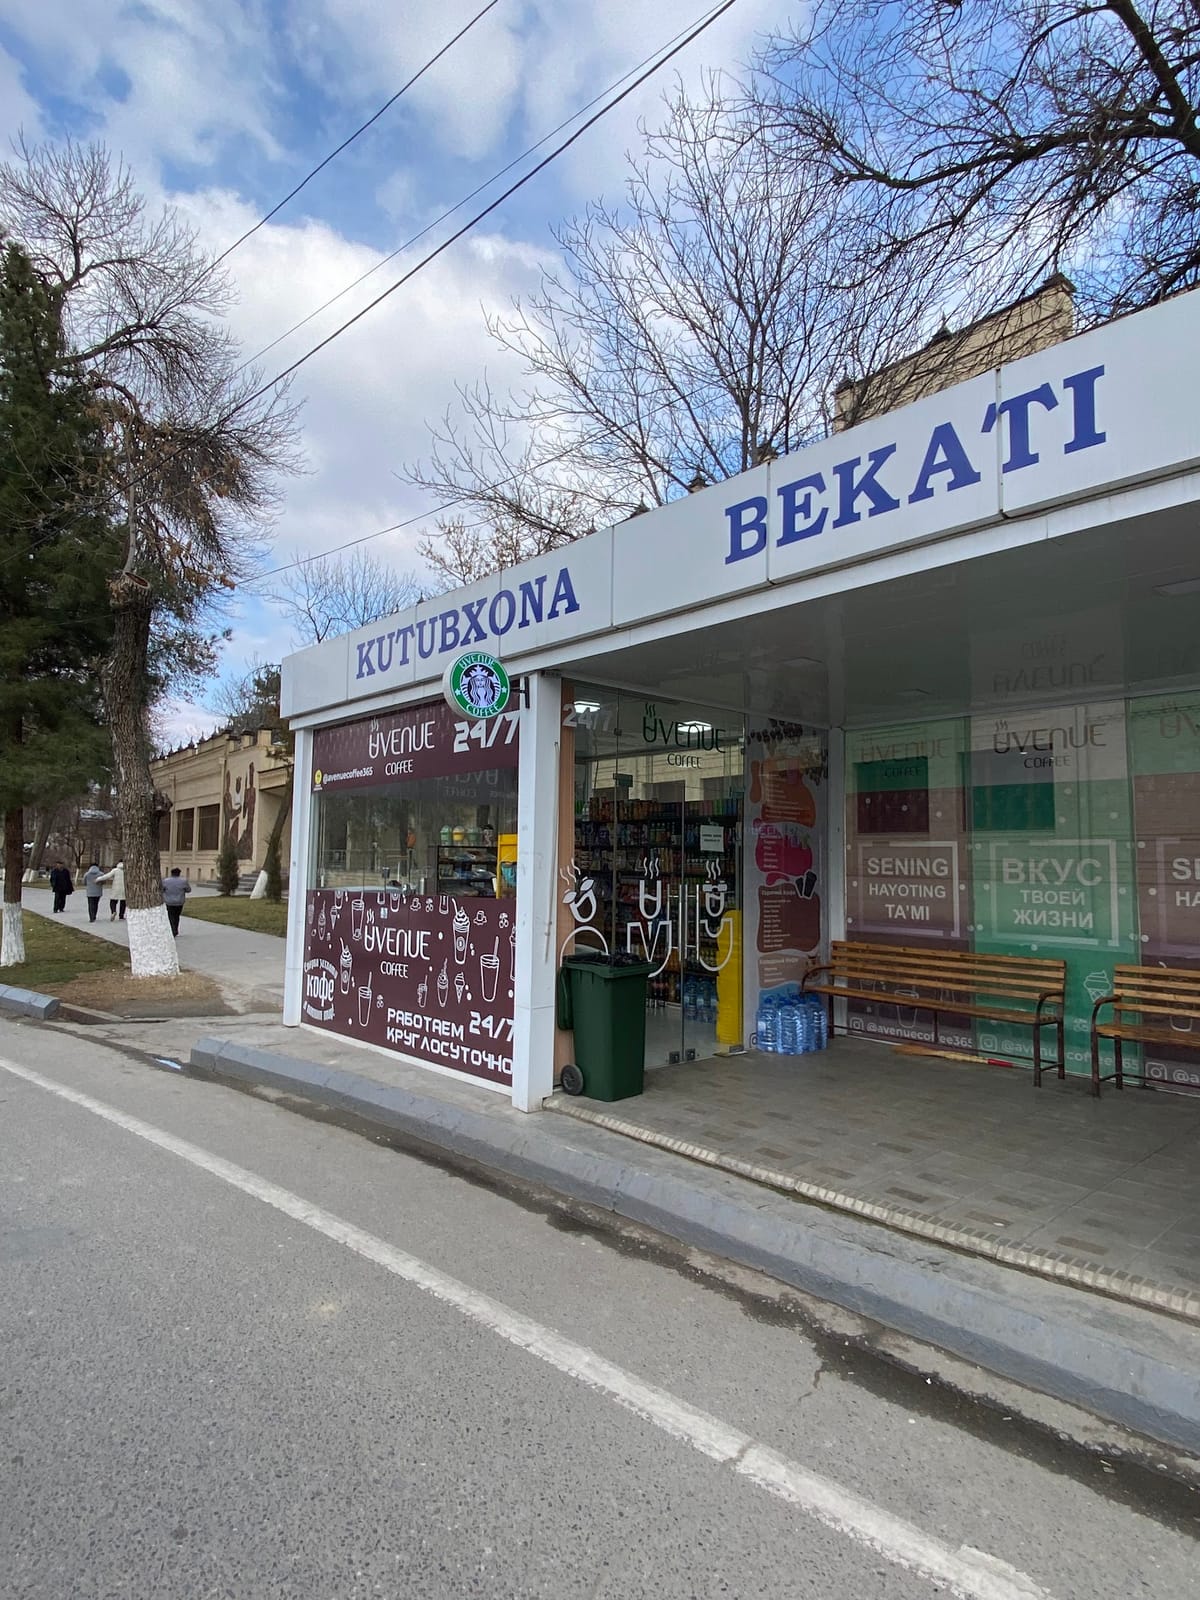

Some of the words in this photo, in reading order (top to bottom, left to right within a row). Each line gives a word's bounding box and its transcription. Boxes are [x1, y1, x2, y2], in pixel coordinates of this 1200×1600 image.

[725, 365, 1107, 565] BEKATI
[356, 567, 580, 680] KUTUBXONA
[466, 703, 500, 717] COFFEE
[453, 710, 520, 753] 24/7
[385, 759, 414, 776] COFFEE
[667, 753, 704, 769] COFFEE
[1024, 754, 1072, 770] COFFEE
[867, 857, 949, 877] SENING
[1002, 857, 1103, 887] ВКУС
[869, 883, 946, 898] HAYOTING
[1020, 888, 1085, 906] ТВОЕЙ
[885, 904, 930, 921] TA'MI
[1013, 909, 1094, 929] ЖИЗНИ
[380, 961, 409, 979] COFFEE
[306, 970, 335, 1007] кофе
[387, 1007, 464, 1042] РАБОТАЕМ
[469, 1011, 514, 1042] 24/7
[866, 1022, 973, 1048] @avenuecofee365
[386, 1026, 513, 1075] КРУГЛОСУТОЧНО
